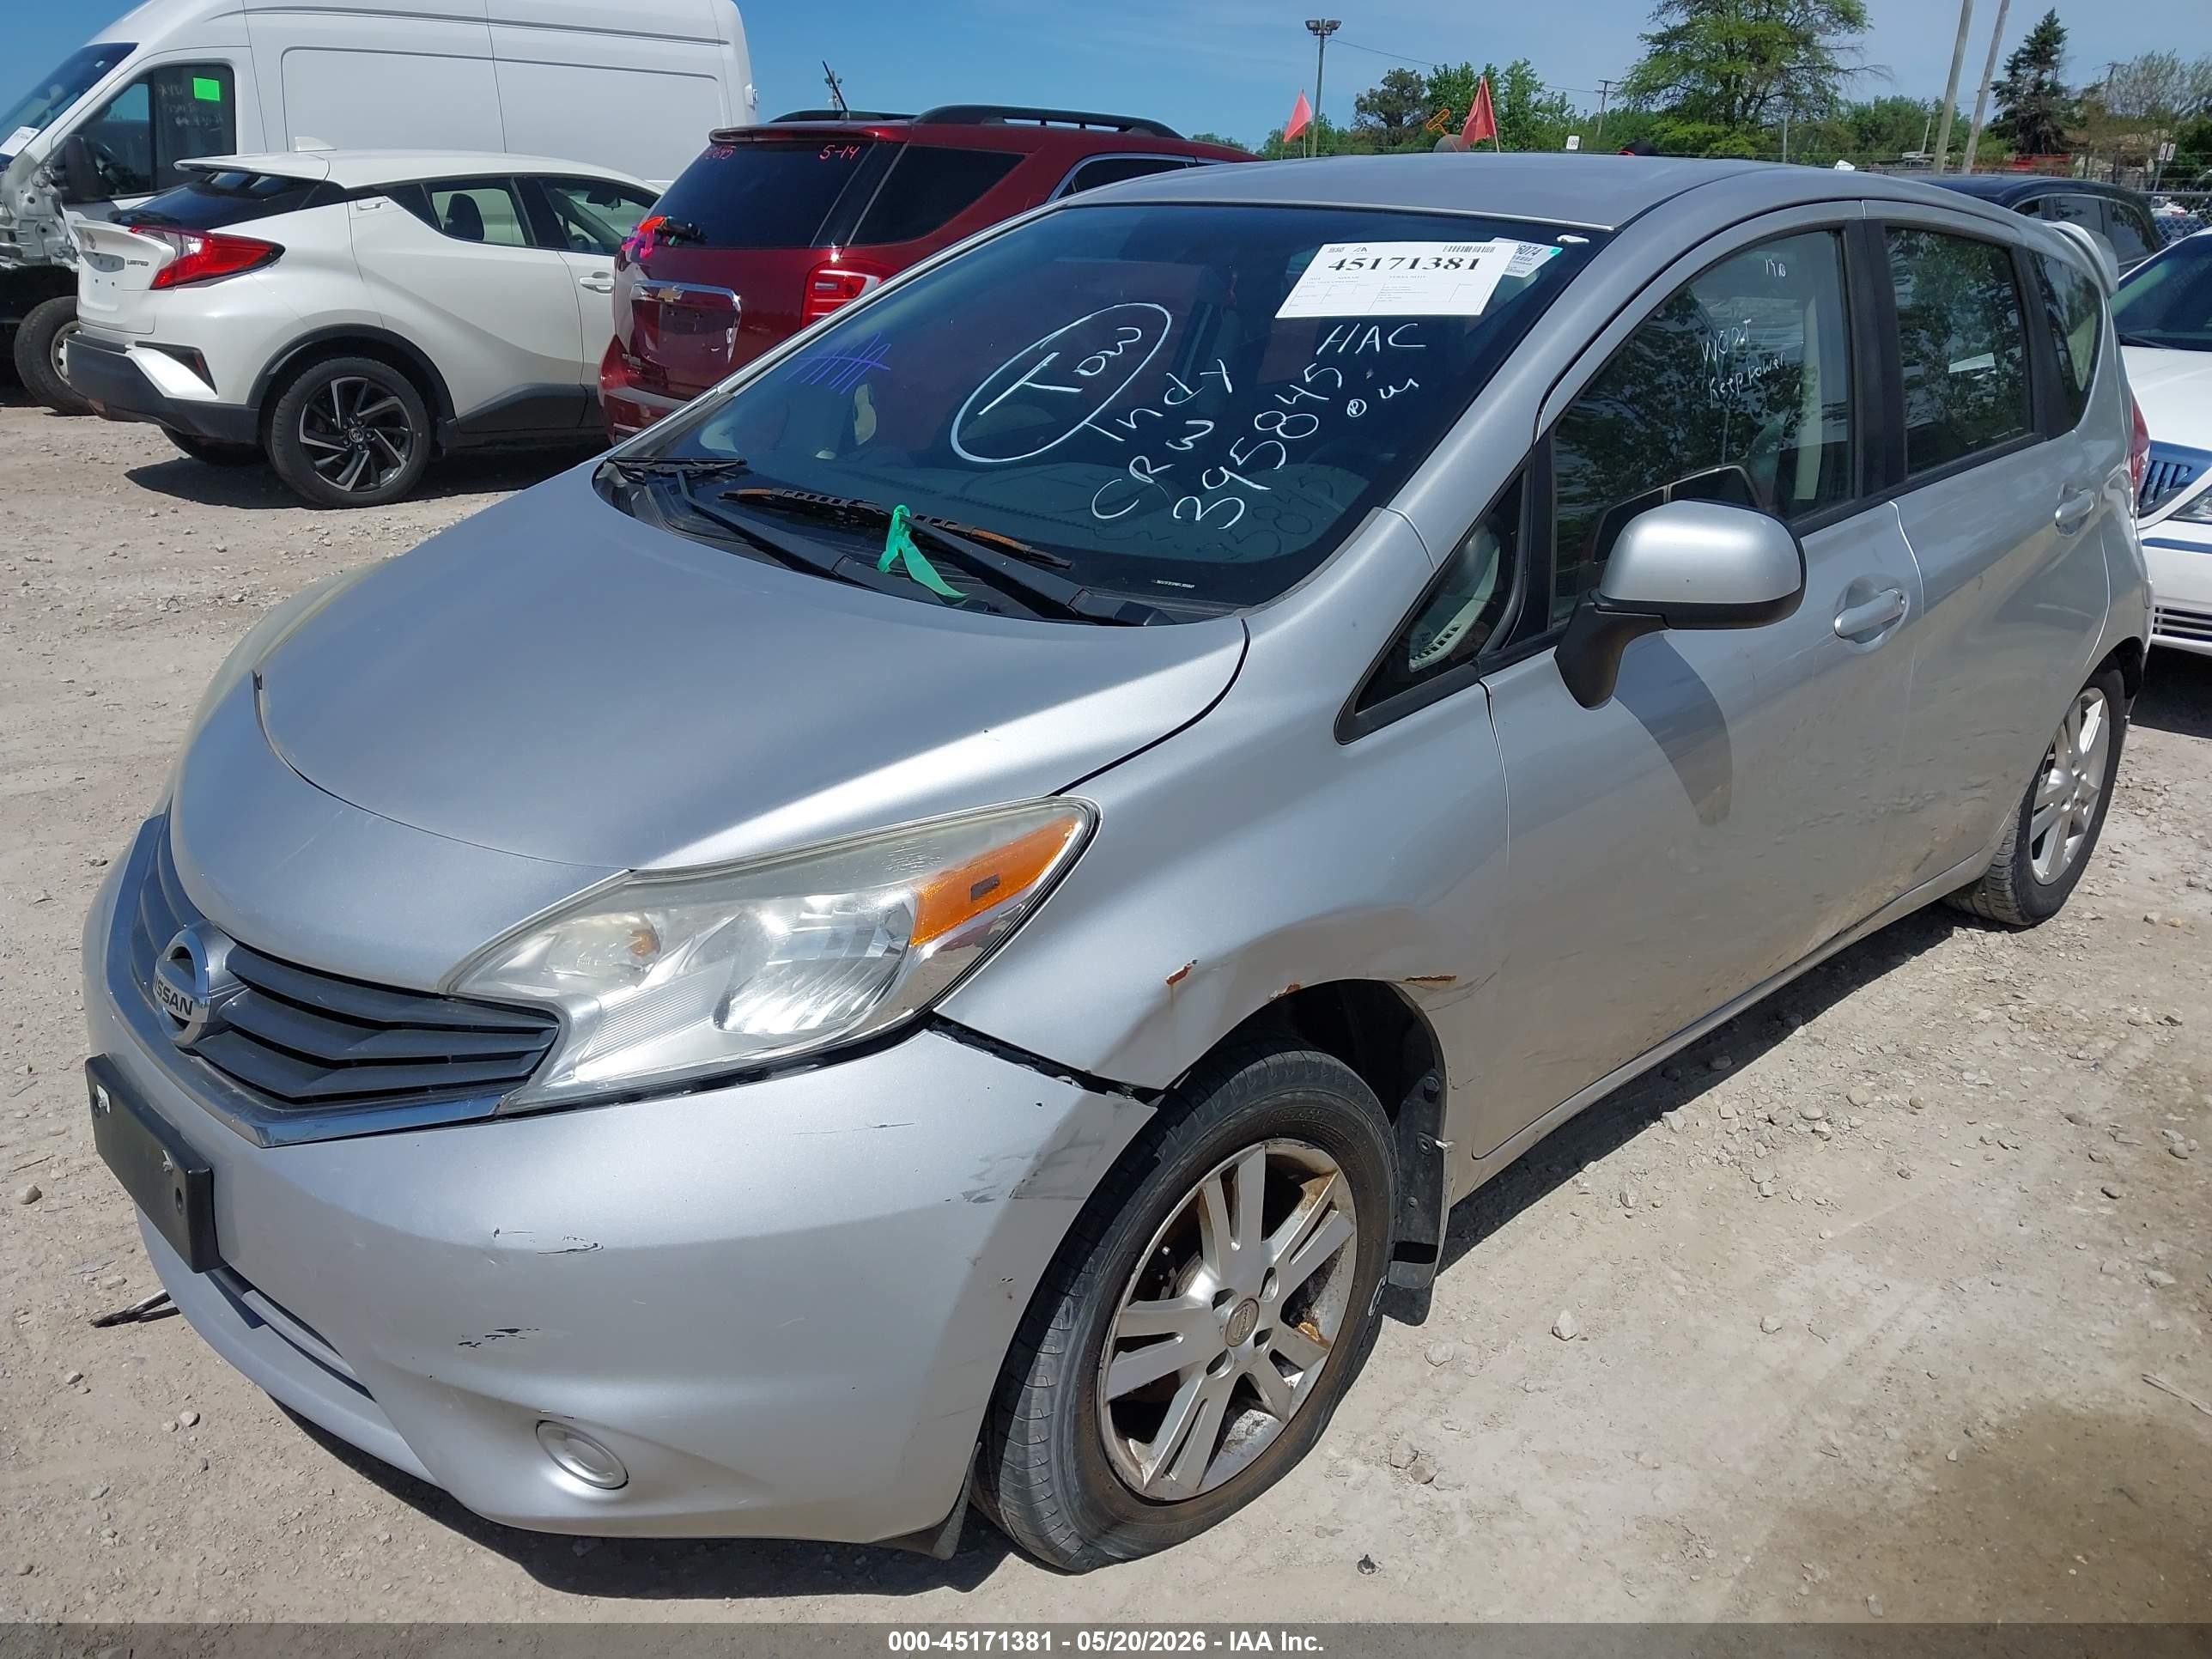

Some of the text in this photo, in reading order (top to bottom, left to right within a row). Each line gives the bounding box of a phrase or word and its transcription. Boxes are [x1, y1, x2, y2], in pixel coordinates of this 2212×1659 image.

[818, 144, 861, 161] 5-14
[1328, 257, 1480, 271] 45171381
[1316, 323, 1427, 356] HAC
[155, 975, 194, 1017] ISSAN
